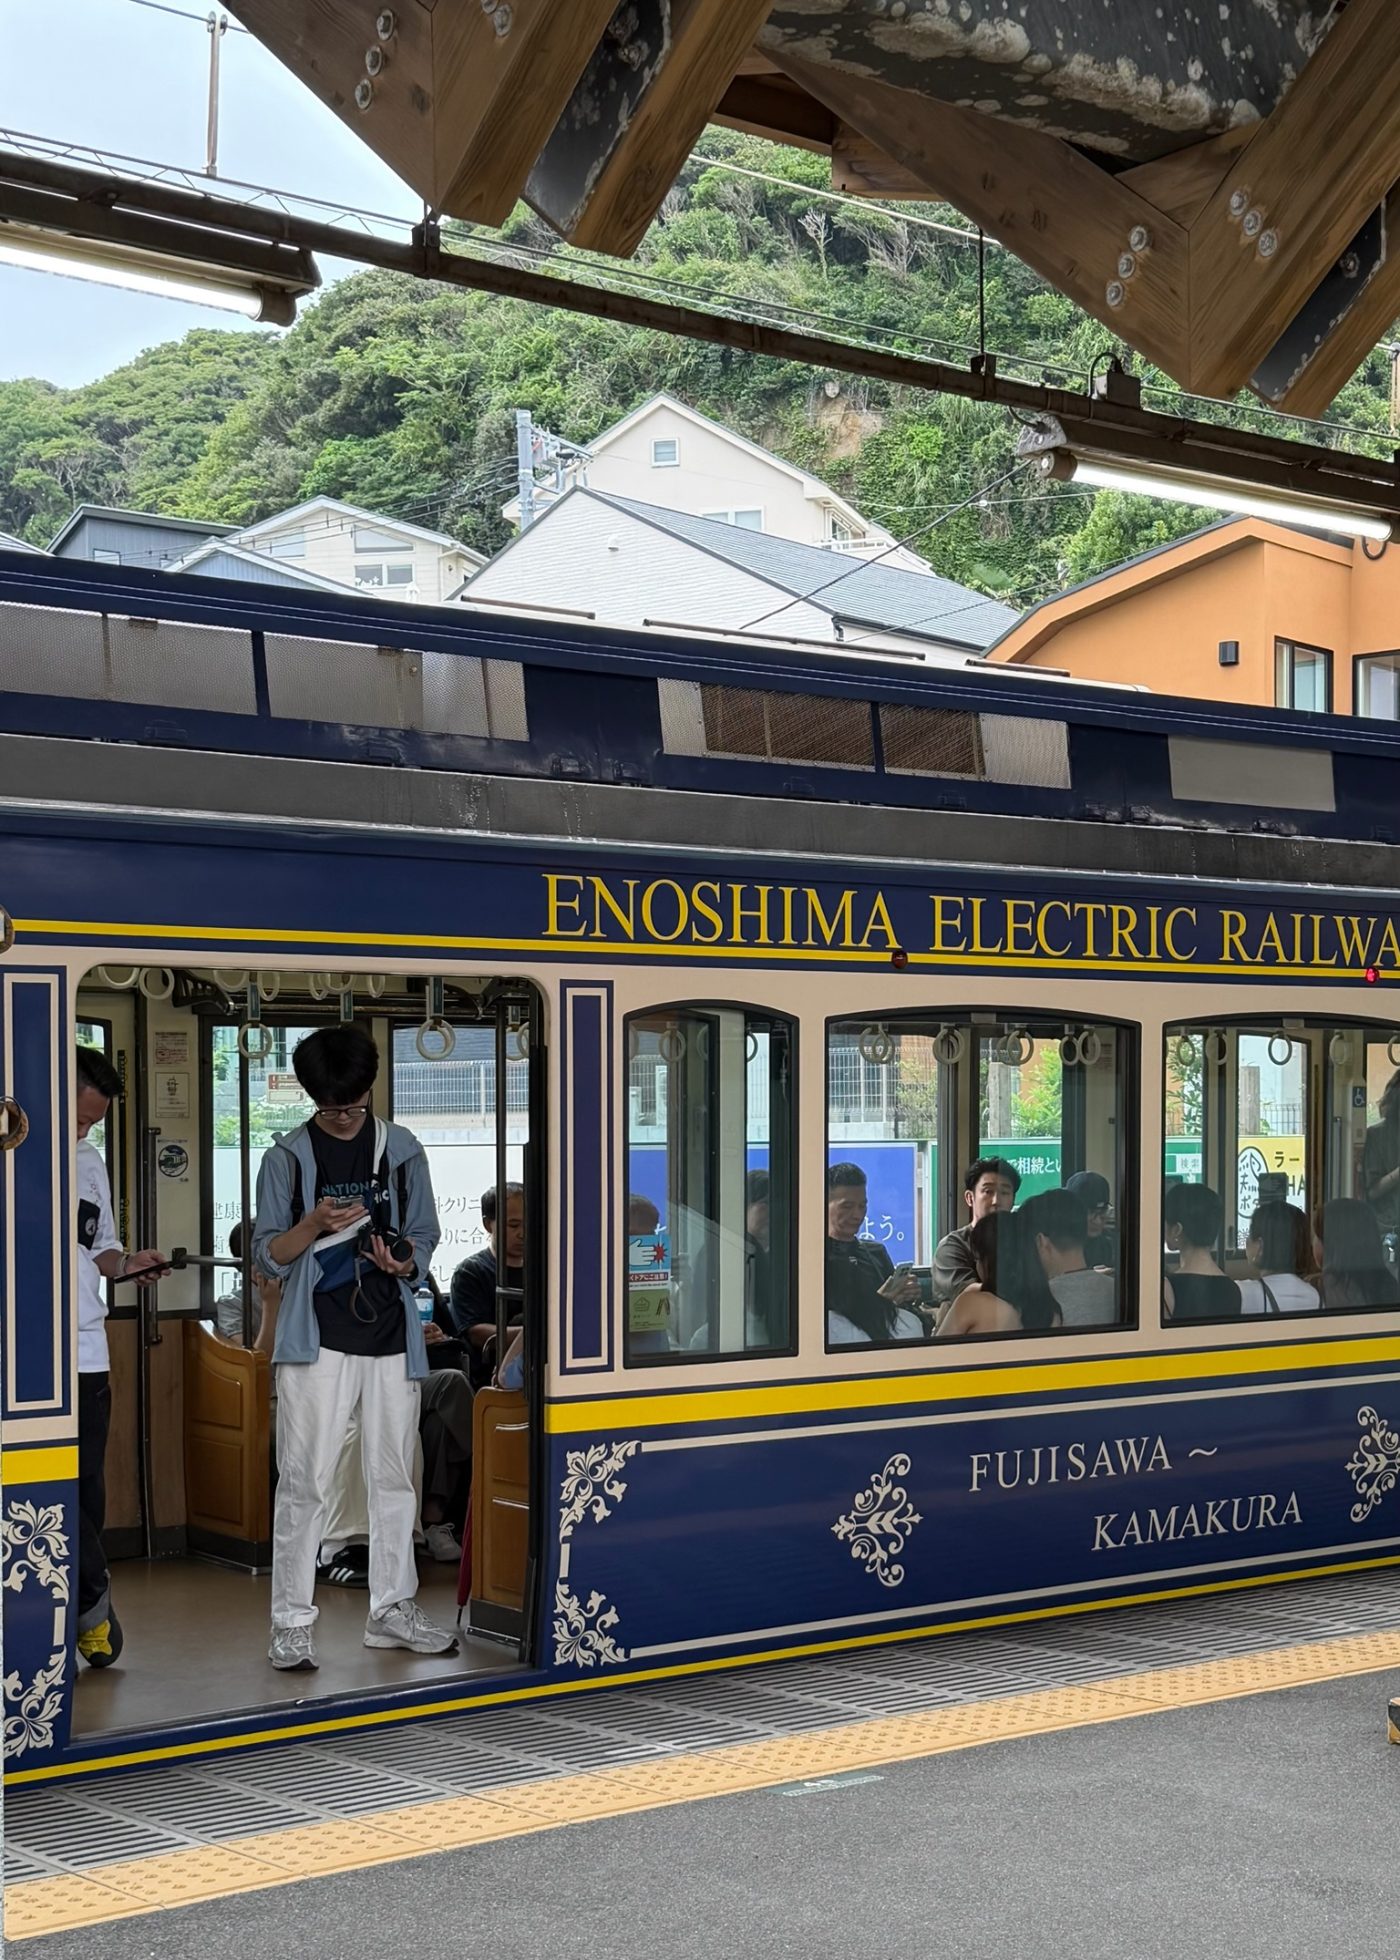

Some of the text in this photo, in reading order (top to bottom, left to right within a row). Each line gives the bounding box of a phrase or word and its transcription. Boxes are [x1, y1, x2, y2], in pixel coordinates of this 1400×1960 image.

[541, 873, 1400, 967] ENOSHIMA ELECTRIC RAILWA
[321, 1181, 370, 1196] NATION
[438, 1226, 492, 1246] りに合
[968, 1435, 1173, 1492] FUJISAWA
[1091, 1490, 1304, 1551] KAMAKURA
